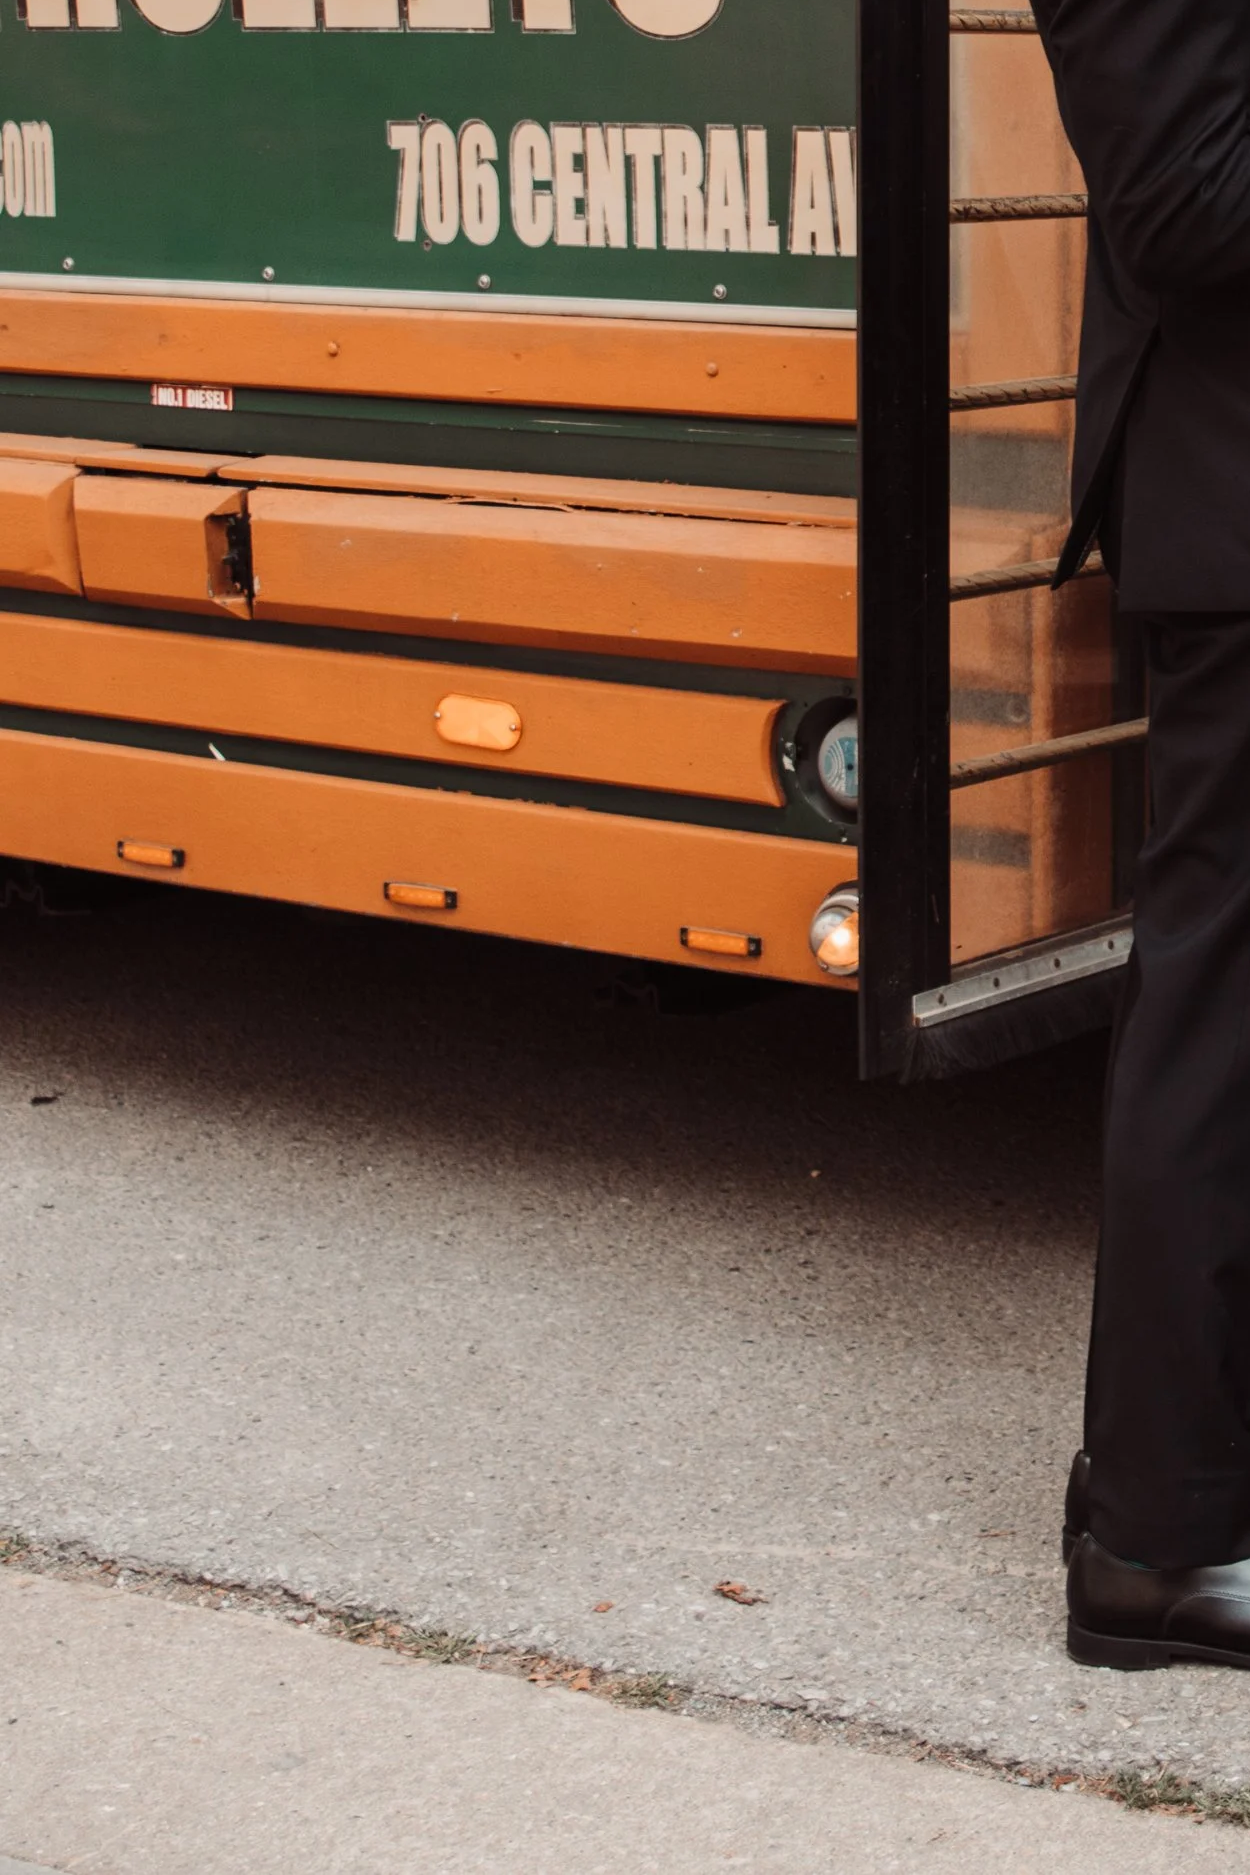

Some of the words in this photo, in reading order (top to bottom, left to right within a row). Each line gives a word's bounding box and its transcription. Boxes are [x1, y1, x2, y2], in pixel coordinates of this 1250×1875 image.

[0, 119, 57, 218] om
[387, 118, 500, 247] 706
[510, 118, 780, 255] CENTRAL
[158, 386, 183, 407] NO.1
[186, 388, 228, 411] DIESEL
